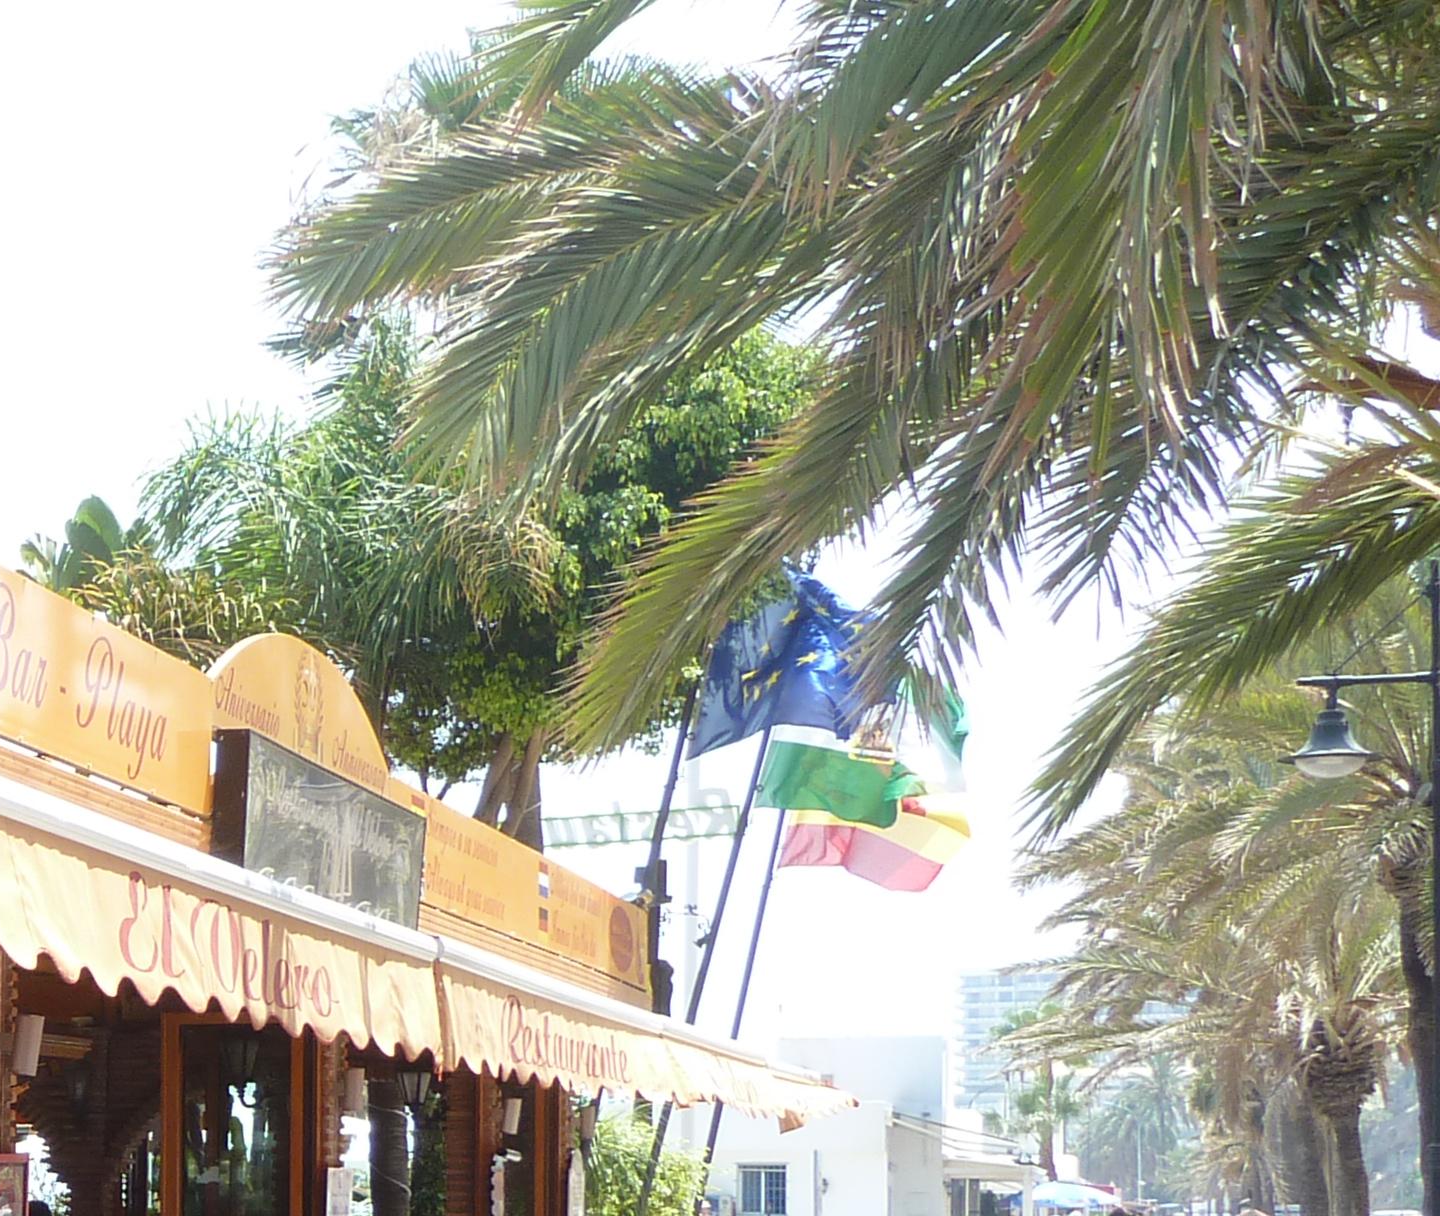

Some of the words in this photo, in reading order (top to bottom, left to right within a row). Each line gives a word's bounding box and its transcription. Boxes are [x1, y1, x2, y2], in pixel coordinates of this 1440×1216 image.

[75, 635, 168, 780] Playa
[120, 870, 185, 978] El
[189, 898, 340, 1018] Velero
[500, 994, 632, 1084] Restaurante
